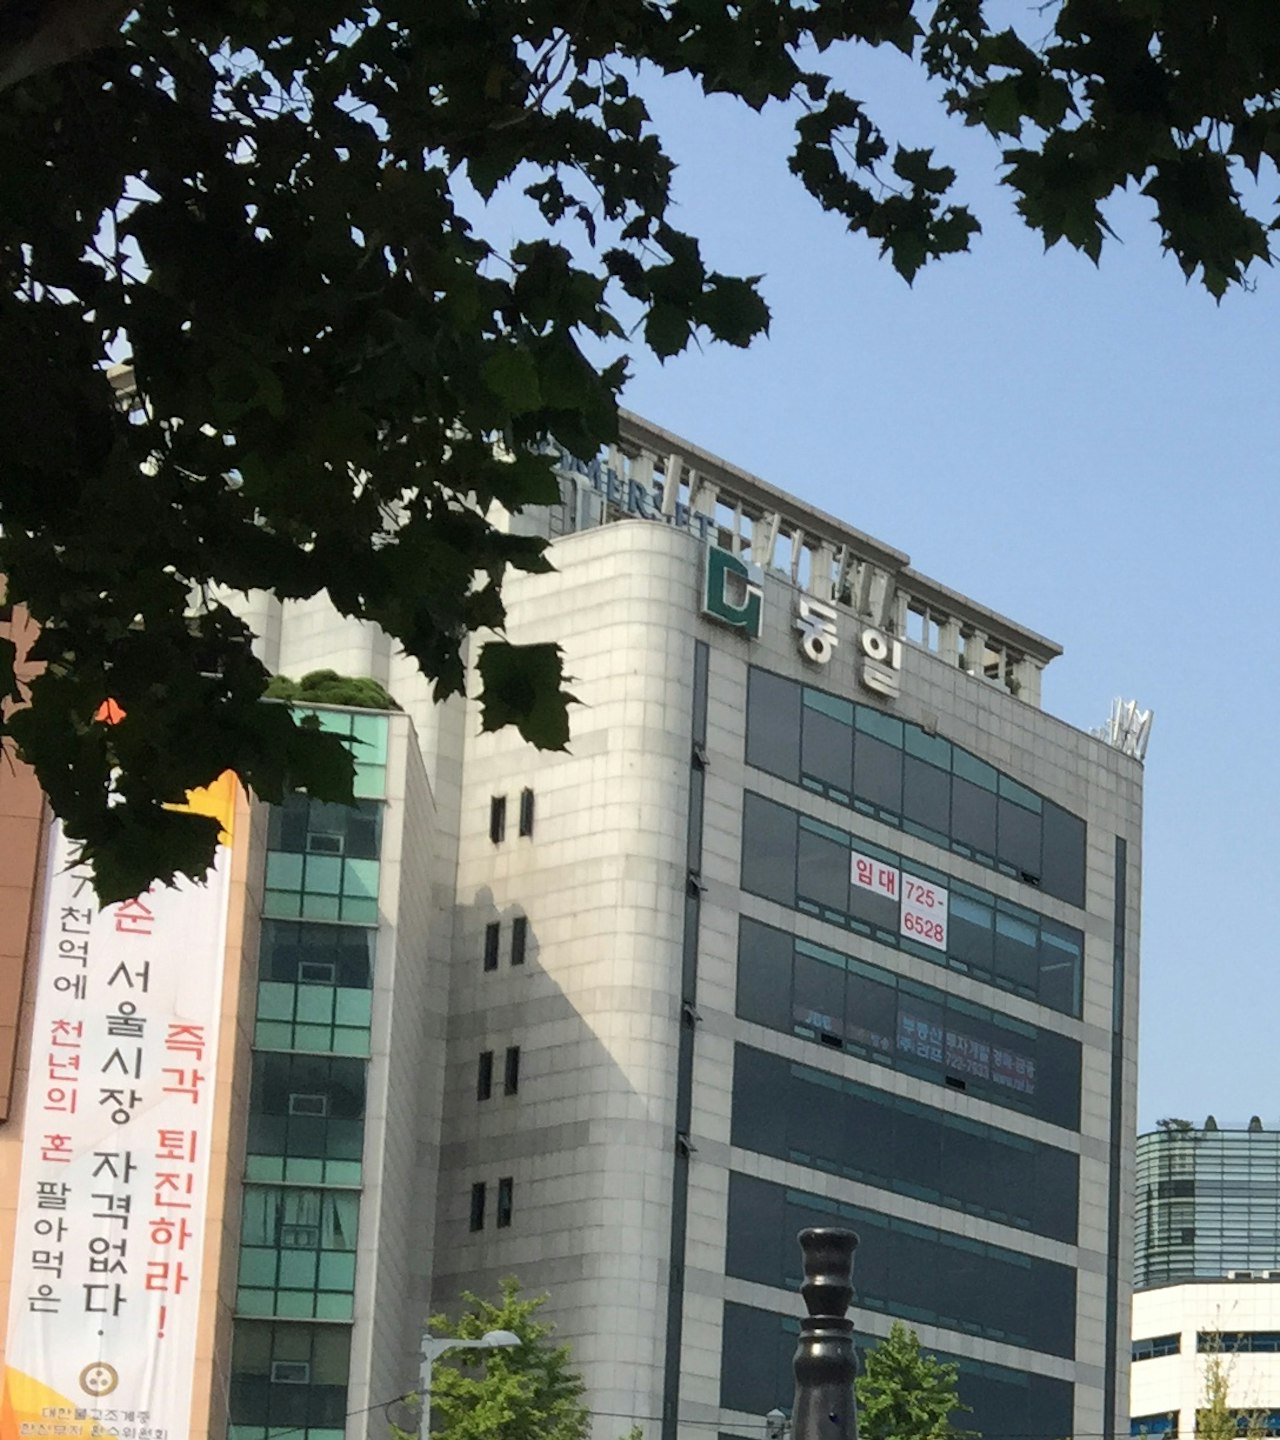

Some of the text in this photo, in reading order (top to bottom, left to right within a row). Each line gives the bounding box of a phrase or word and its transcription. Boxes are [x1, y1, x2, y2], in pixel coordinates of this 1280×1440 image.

[795, 599, 906, 700] 동일
[903, 912, 945, 943] 6528
[44, 1019, 83, 1115] 천년의
[99, 960, 151, 1126] 서울시장
[41, 1134, 73, 1163] 혼
[145, 1023, 206, 1339] 즉각 퇴진하라!
[28, 1181, 72, 1313] 팔아먹은
